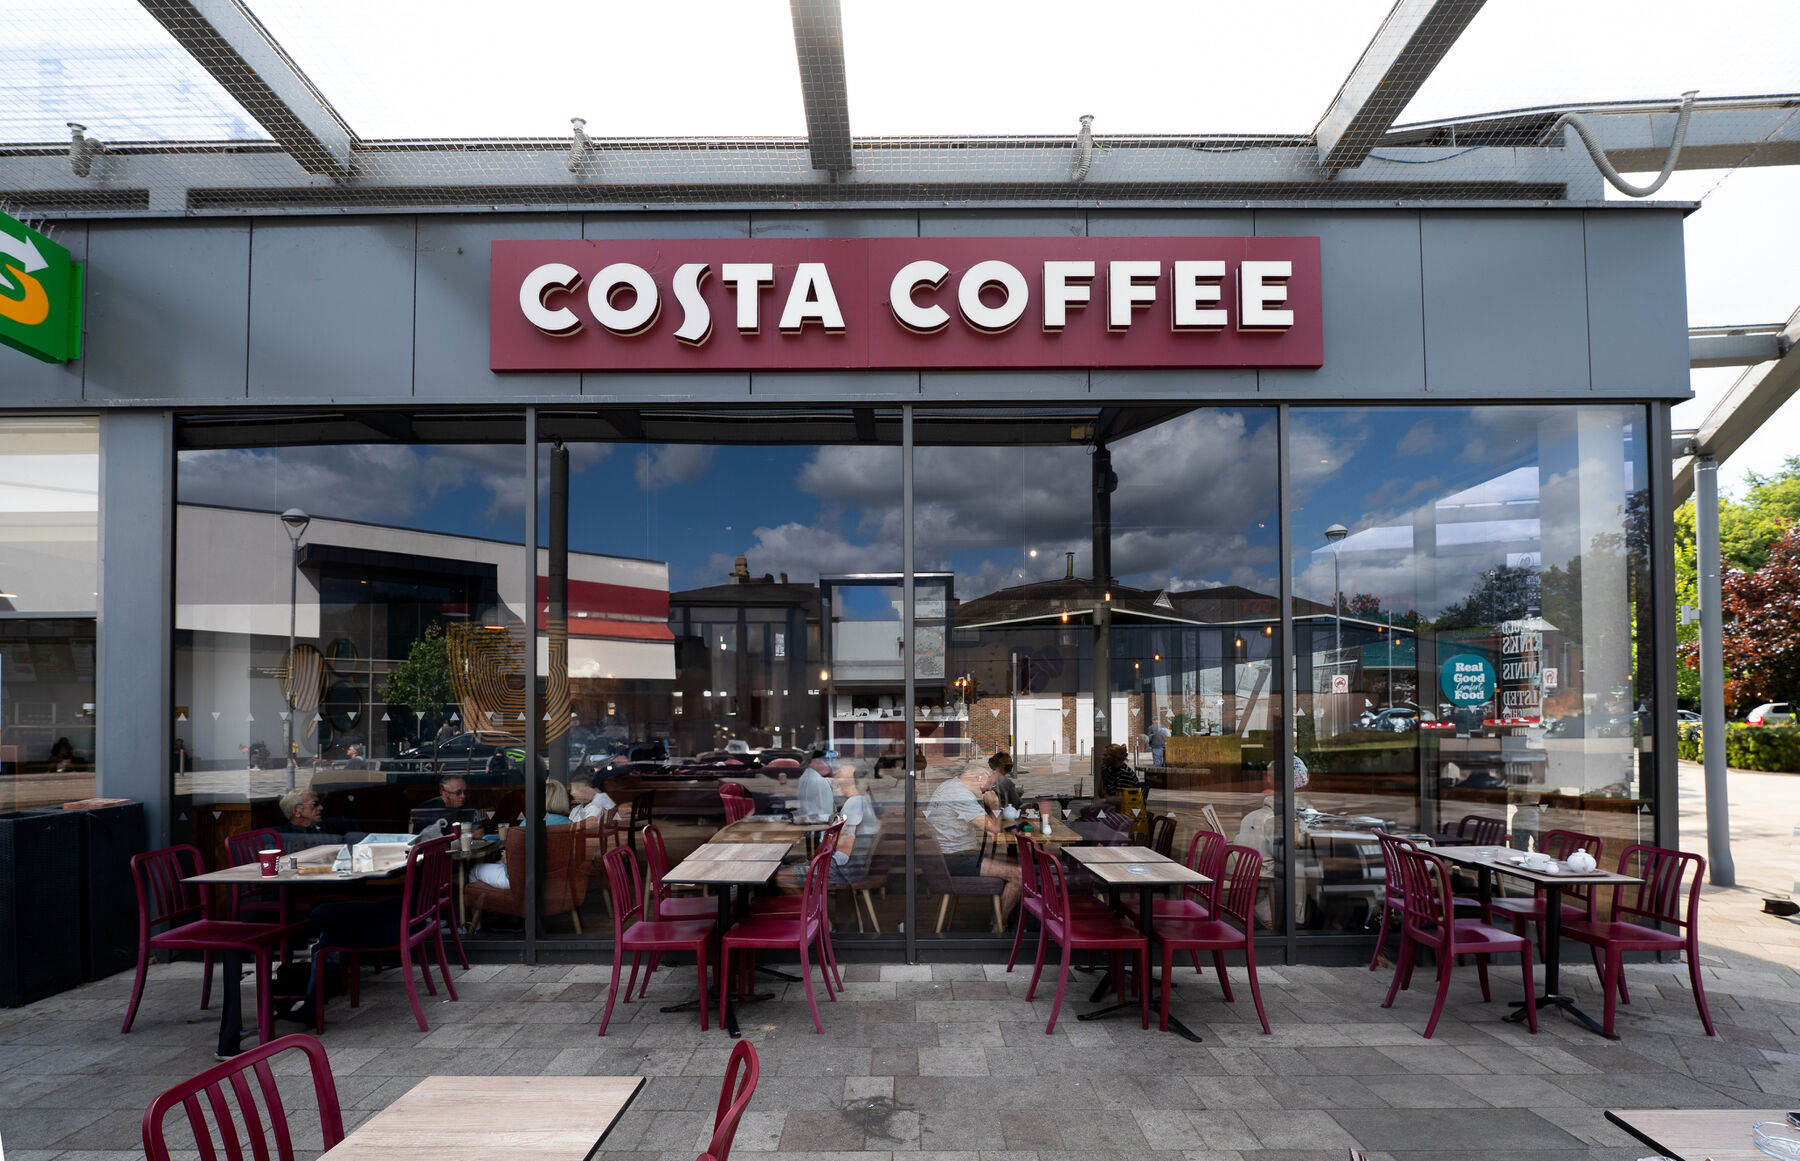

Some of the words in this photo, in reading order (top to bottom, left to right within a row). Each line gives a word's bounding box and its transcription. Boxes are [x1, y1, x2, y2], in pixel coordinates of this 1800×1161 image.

[519, 262, 846, 346] COSTA
[889, 260, 1295, 334] COFFEE
[1455, 662, 1483, 672] Real
[1453, 673, 1485, 684] Good
[1454, 690, 1485, 700] Food
